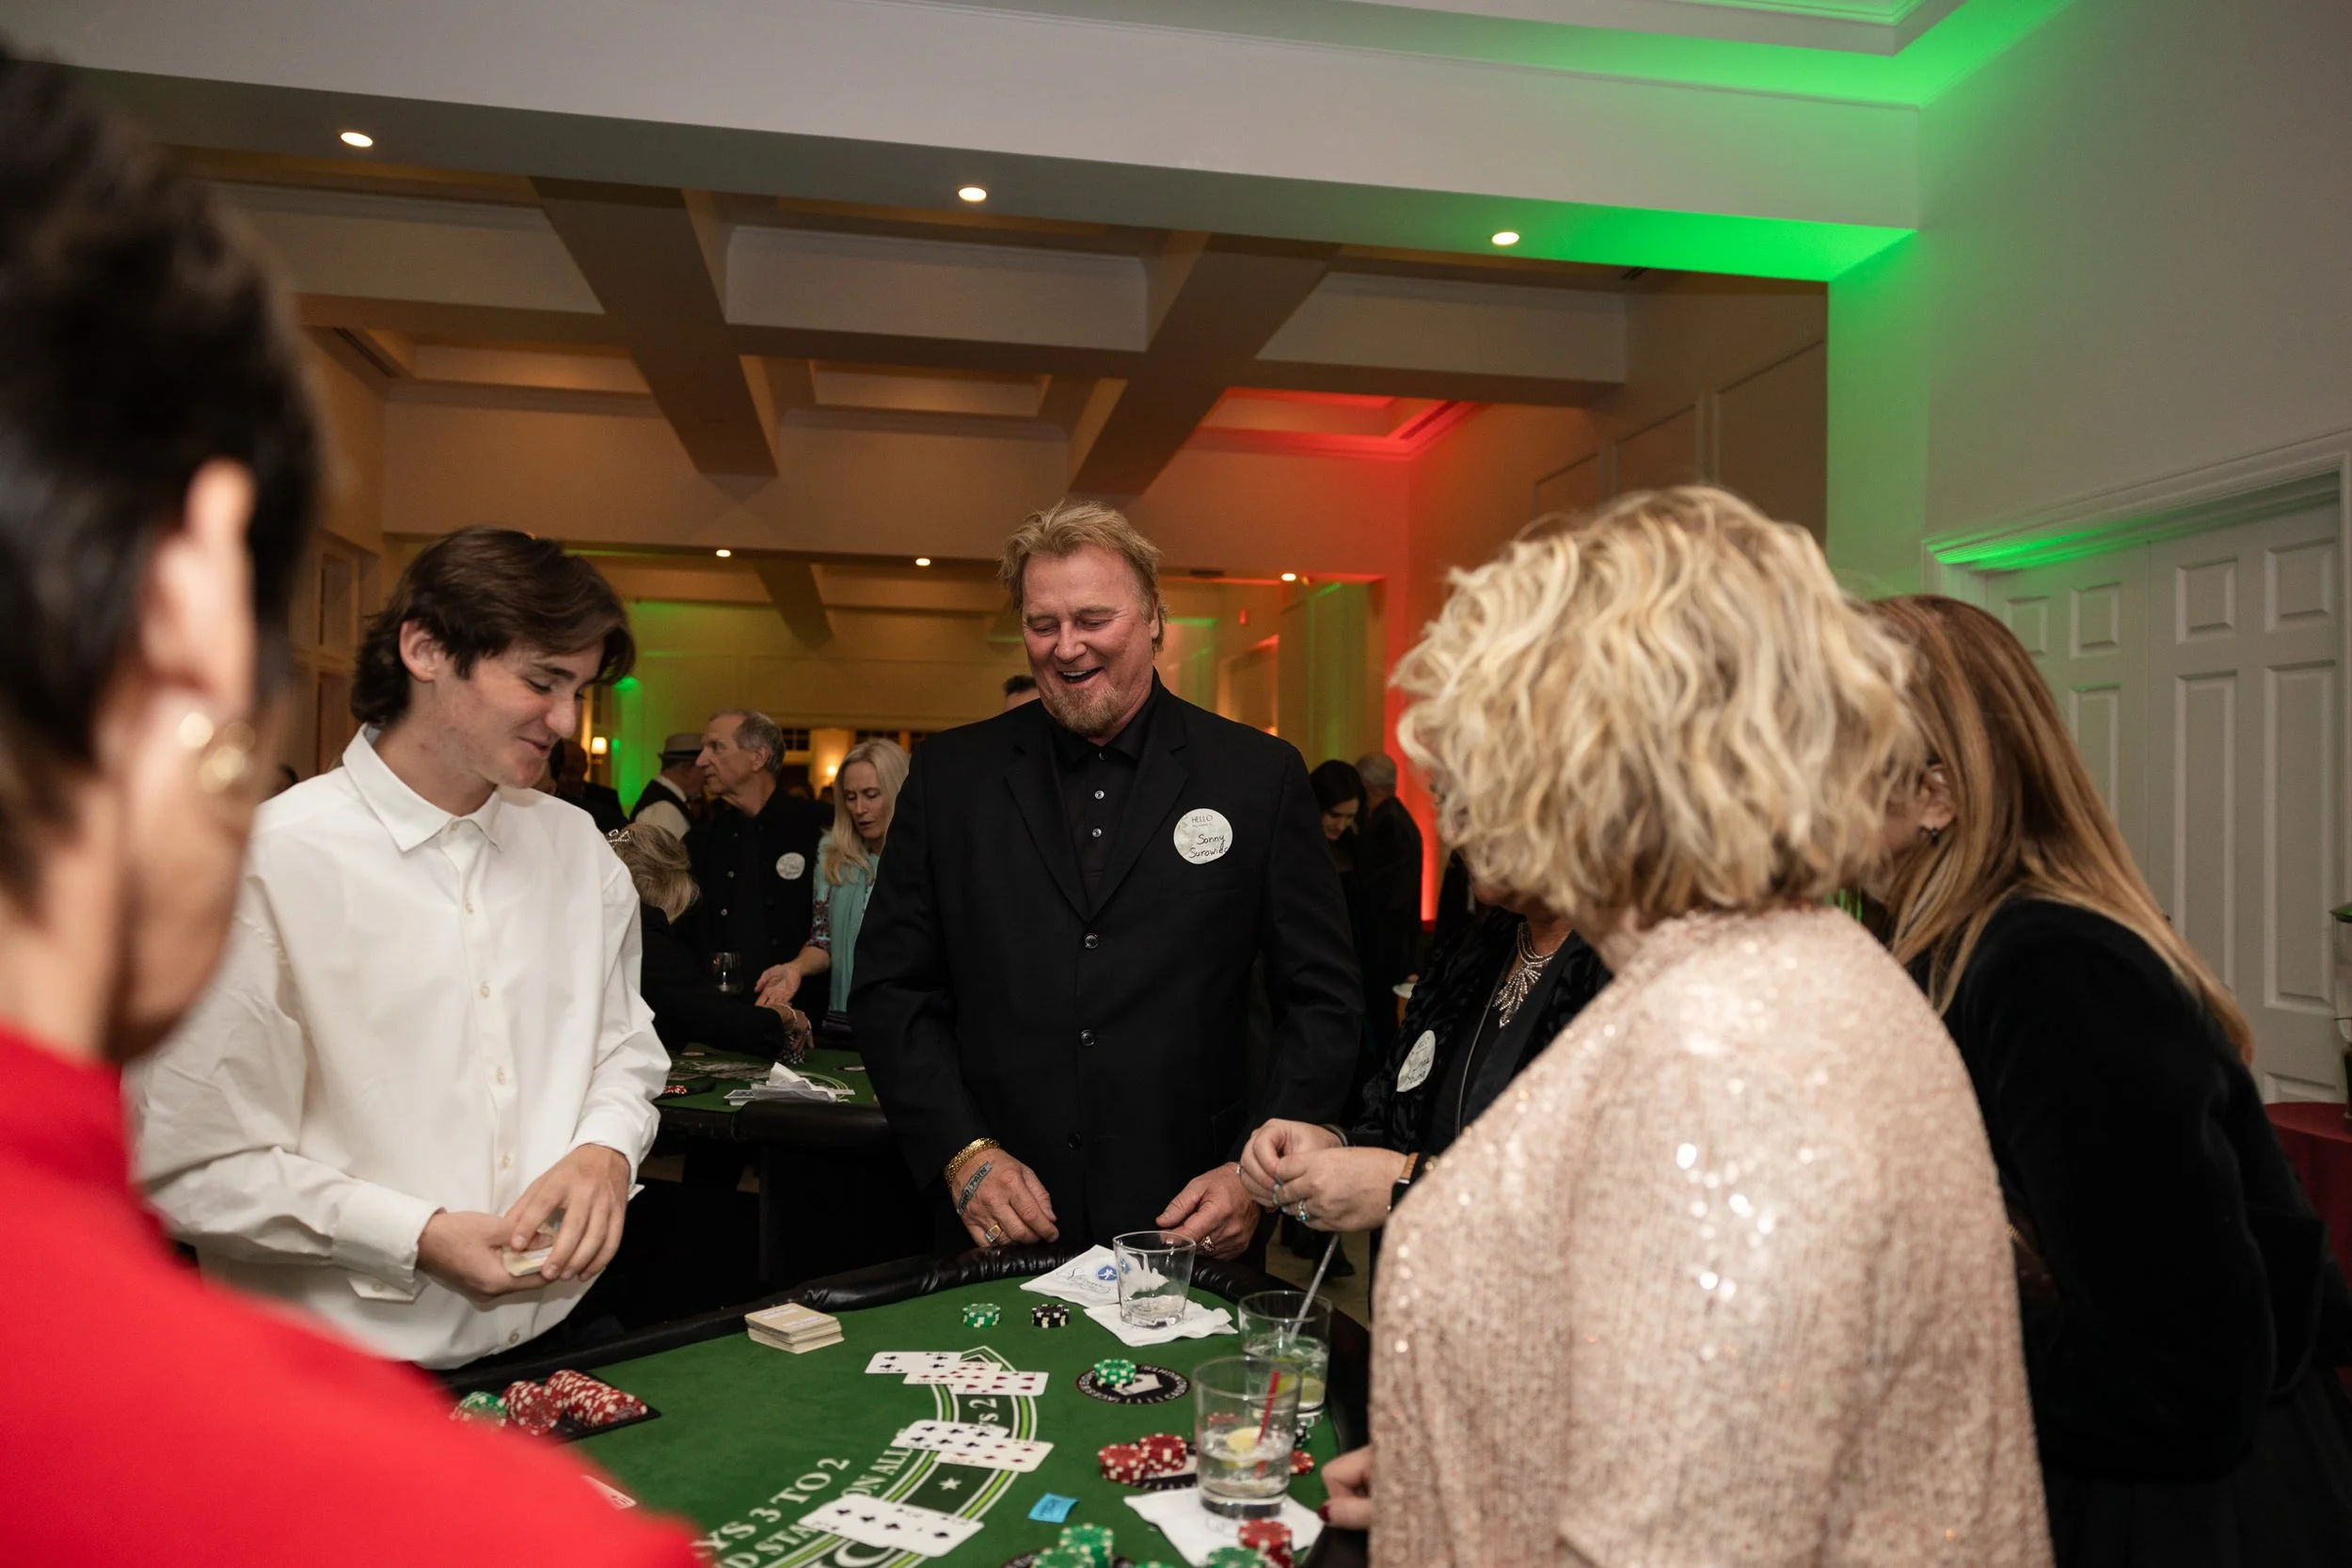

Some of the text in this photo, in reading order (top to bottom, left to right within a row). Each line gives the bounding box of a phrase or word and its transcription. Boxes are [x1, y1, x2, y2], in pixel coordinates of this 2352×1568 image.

[1191, 815, 1214, 823] HELLO
[1197, 833, 1226, 848] Sonny
[749, 1508, 782, 1523] 3
[769, 1472, 832, 1505] TO
[817, 1458, 850, 1470] 2
[754, 1524, 818, 1556] STA
